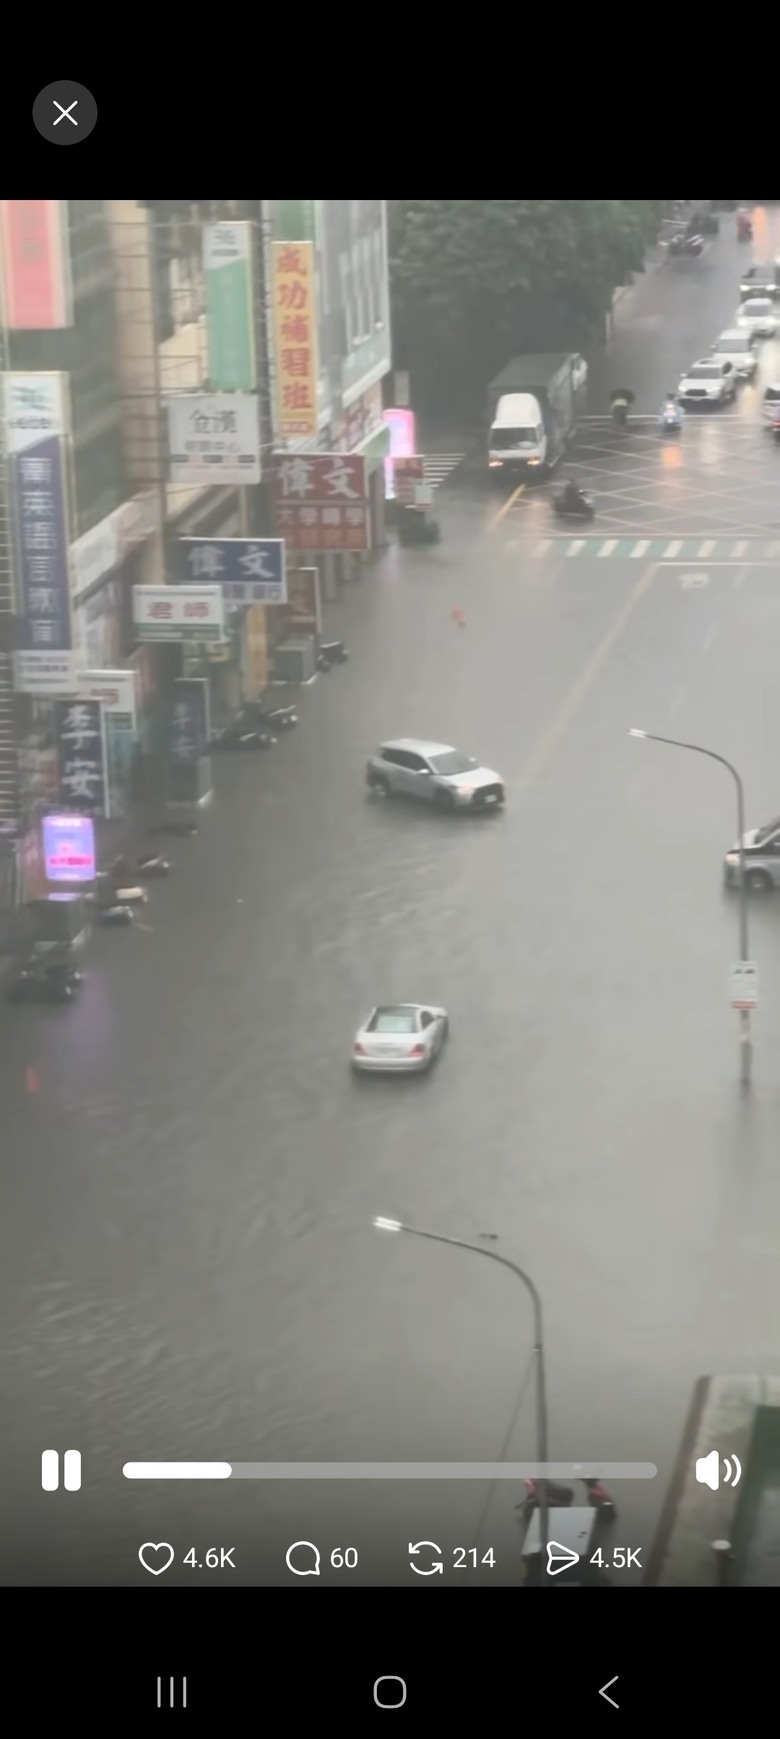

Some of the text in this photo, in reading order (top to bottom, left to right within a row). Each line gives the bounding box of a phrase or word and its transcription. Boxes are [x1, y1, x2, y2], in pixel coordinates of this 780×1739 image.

[277, 246, 313, 410] 成功補習班
[276, 456, 360, 499] 偉文
[186, 544, 275, 579] 偉文
